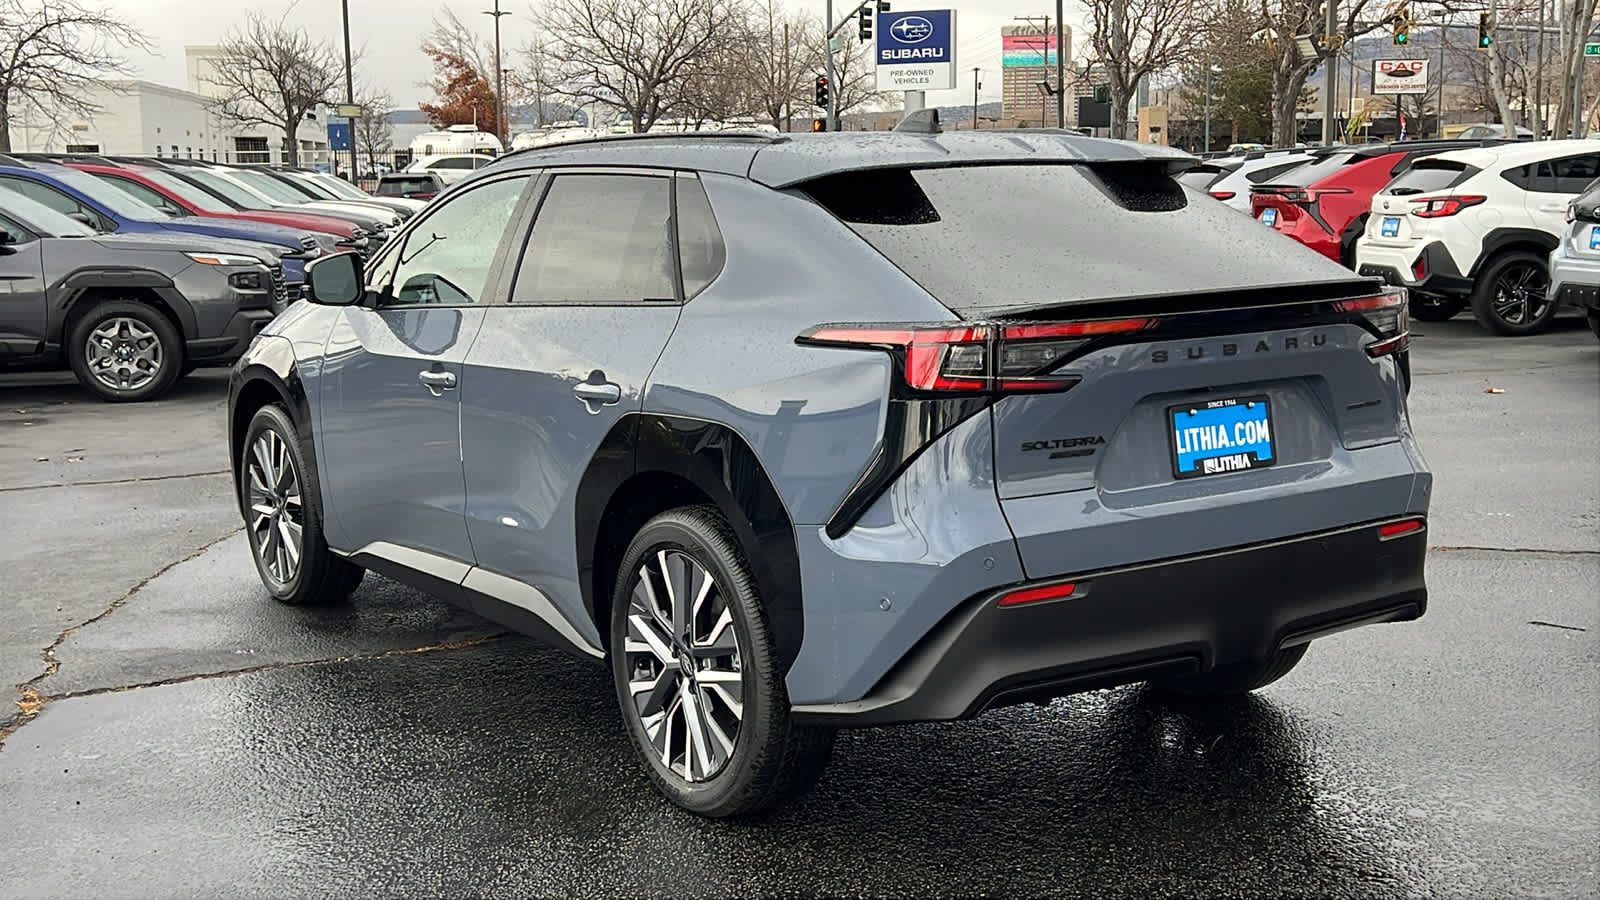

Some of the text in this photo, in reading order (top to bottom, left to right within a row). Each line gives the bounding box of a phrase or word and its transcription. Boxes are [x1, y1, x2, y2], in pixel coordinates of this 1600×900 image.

[881, 47, 943, 60] SUBARU
[890, 69, 934, 77] PRE-OWNED
[894, 77, 929, 85] VEHICLES
[1151, 334, 1327, 363] SUBARU
[1207, 400, 1224, 409] SINCE
[1021, 435, 1106, 452] SOLTERRA
[1175, 418, 1271, 454] LITHIA.COM
[1215, 453, 1251, 471] LITHIA
